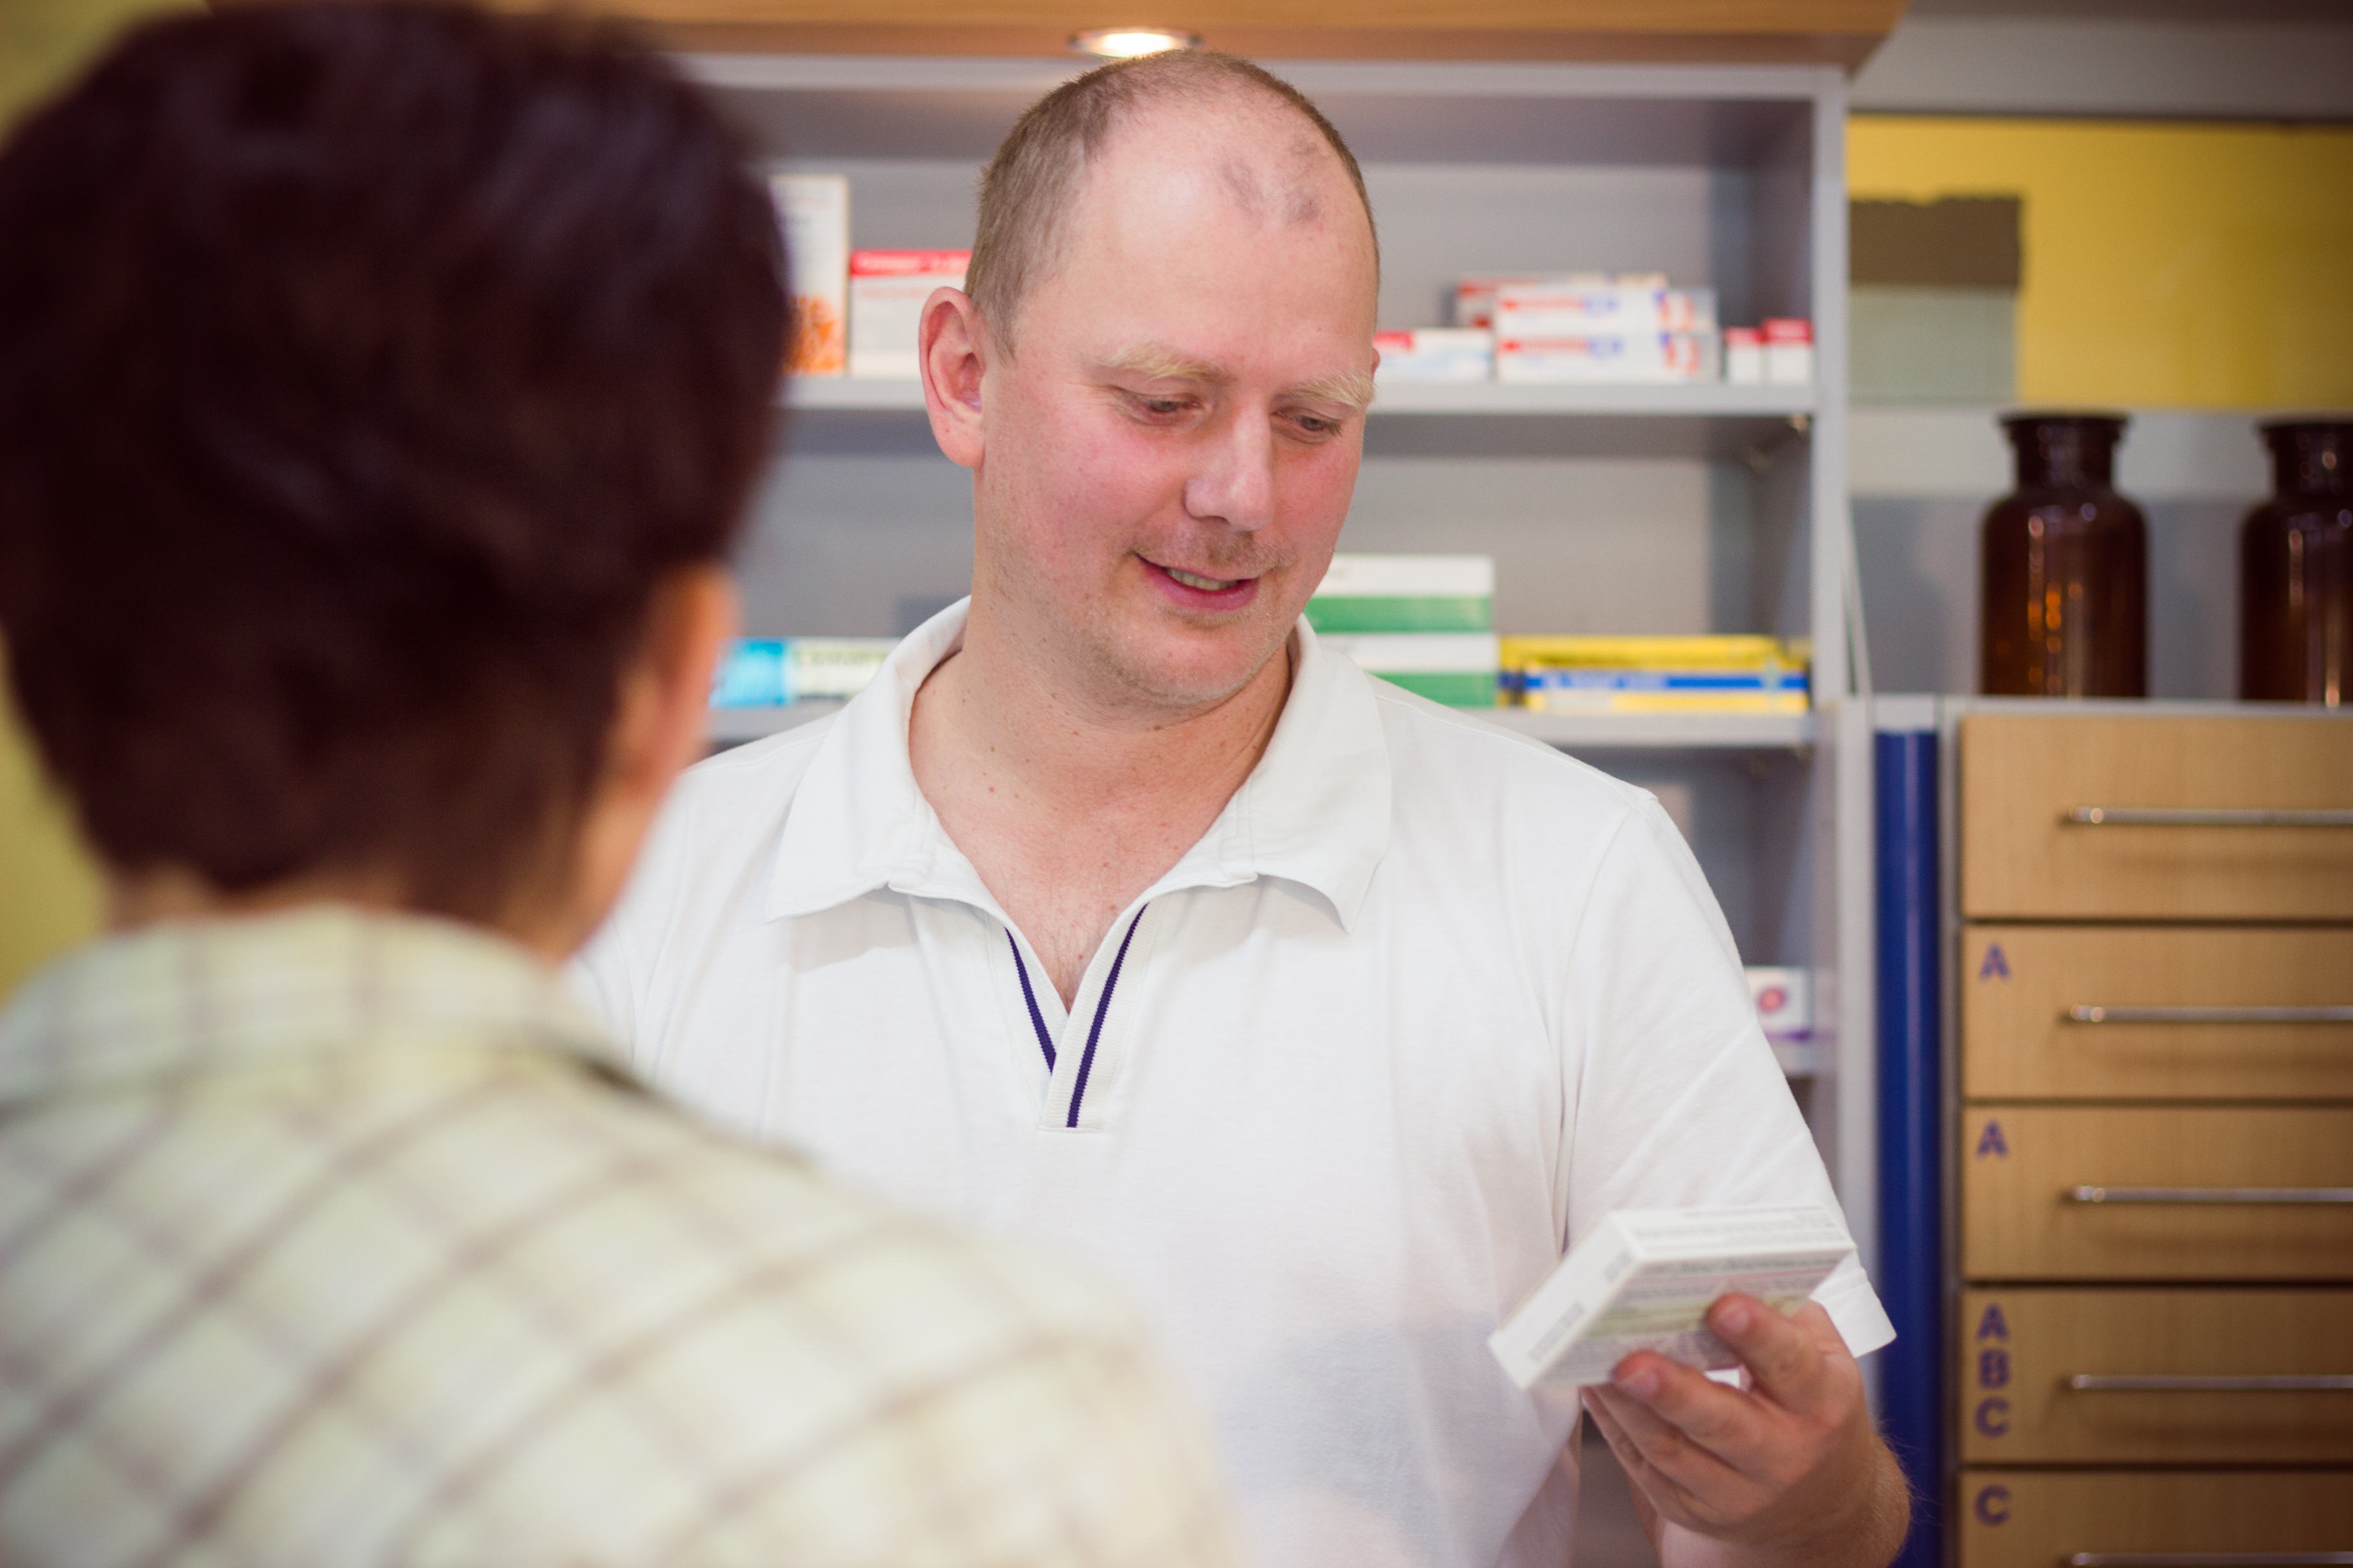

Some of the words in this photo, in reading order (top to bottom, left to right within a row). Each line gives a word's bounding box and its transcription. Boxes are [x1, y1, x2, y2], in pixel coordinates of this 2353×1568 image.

[1979, 942, 2011, 981] A
[1976, 1120, 2009, 1158] A
[1976, 1303, 2009, 1342] A
[1978, 1348, 2011, 1390] B
[1974, 1397, 2011, 1438] C
[1974, 1484, 2011, 1527] C
